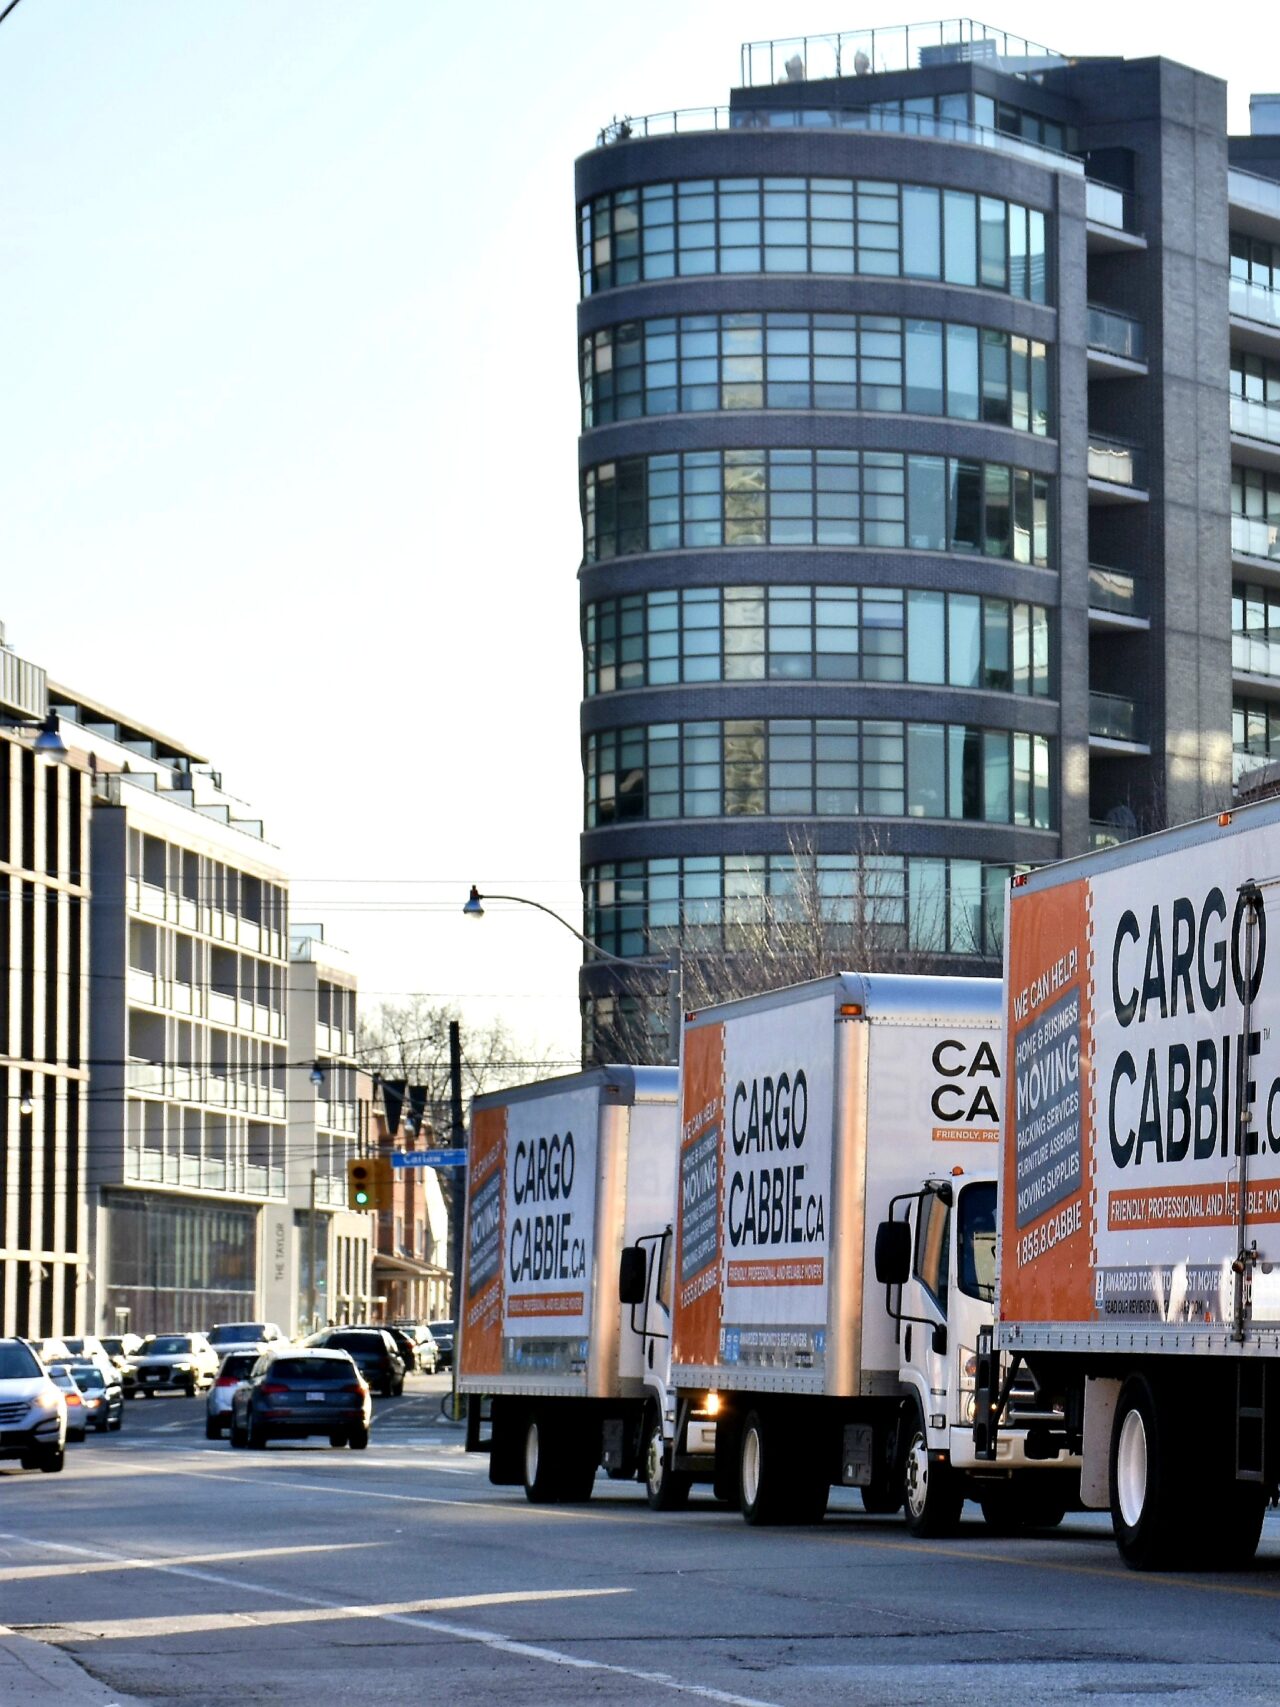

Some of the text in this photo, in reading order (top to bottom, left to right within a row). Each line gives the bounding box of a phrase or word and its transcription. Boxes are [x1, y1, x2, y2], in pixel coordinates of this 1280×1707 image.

[1014, 946, 1079, 1022] WE CAN HELP!
[1110, 877, 1267, 1028] CARGO
[1016, 1000, 1079, 1065] HOME & BUSINESS
[1017, 1033, 1079, 1121] MOVING
[732, 1068, 808, 1157] CARGO
[1017, 1091, 1080, 1153] PACKING SERVICES
[513, 1130, 575, 1206] CARGO
[683, 1154, 718, 1210] MOVING
[1017, 1120, 1080, 1181] FURNITURE ASSEMBLY
[1017, 1151, 1080, 1214] MOVING SUPPLIES
[1148, 1194, 1205, 1219] PROFESSIONAL
[1205, 1194, 1223, 1216] AND
[1105, 1271, 1138, 1292] AWARDED
